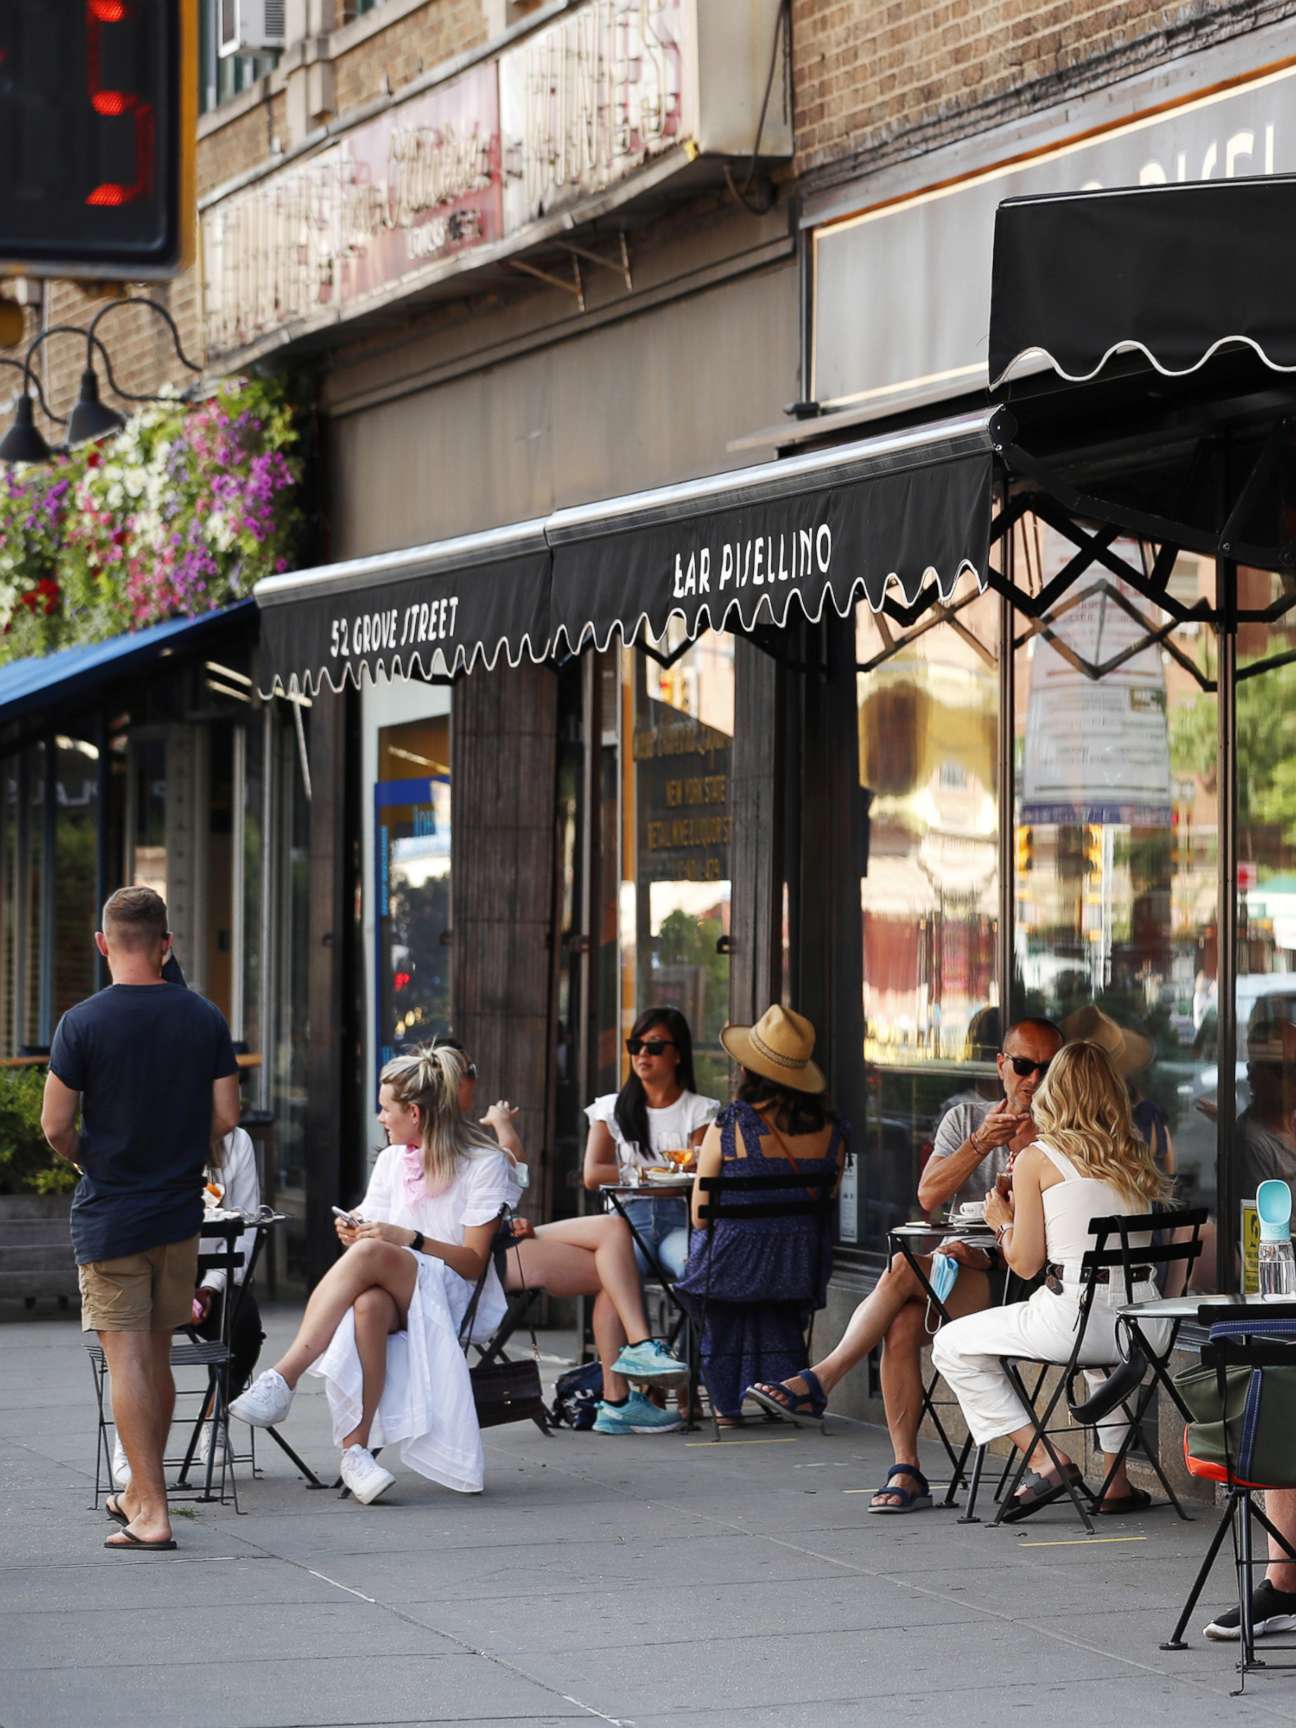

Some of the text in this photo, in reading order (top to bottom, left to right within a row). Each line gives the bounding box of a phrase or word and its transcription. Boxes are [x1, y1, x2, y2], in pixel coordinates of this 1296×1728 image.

[718, 523, 832, 591] PISELLINO
[330, 596, 459, 658] 52 GROVE STREET
